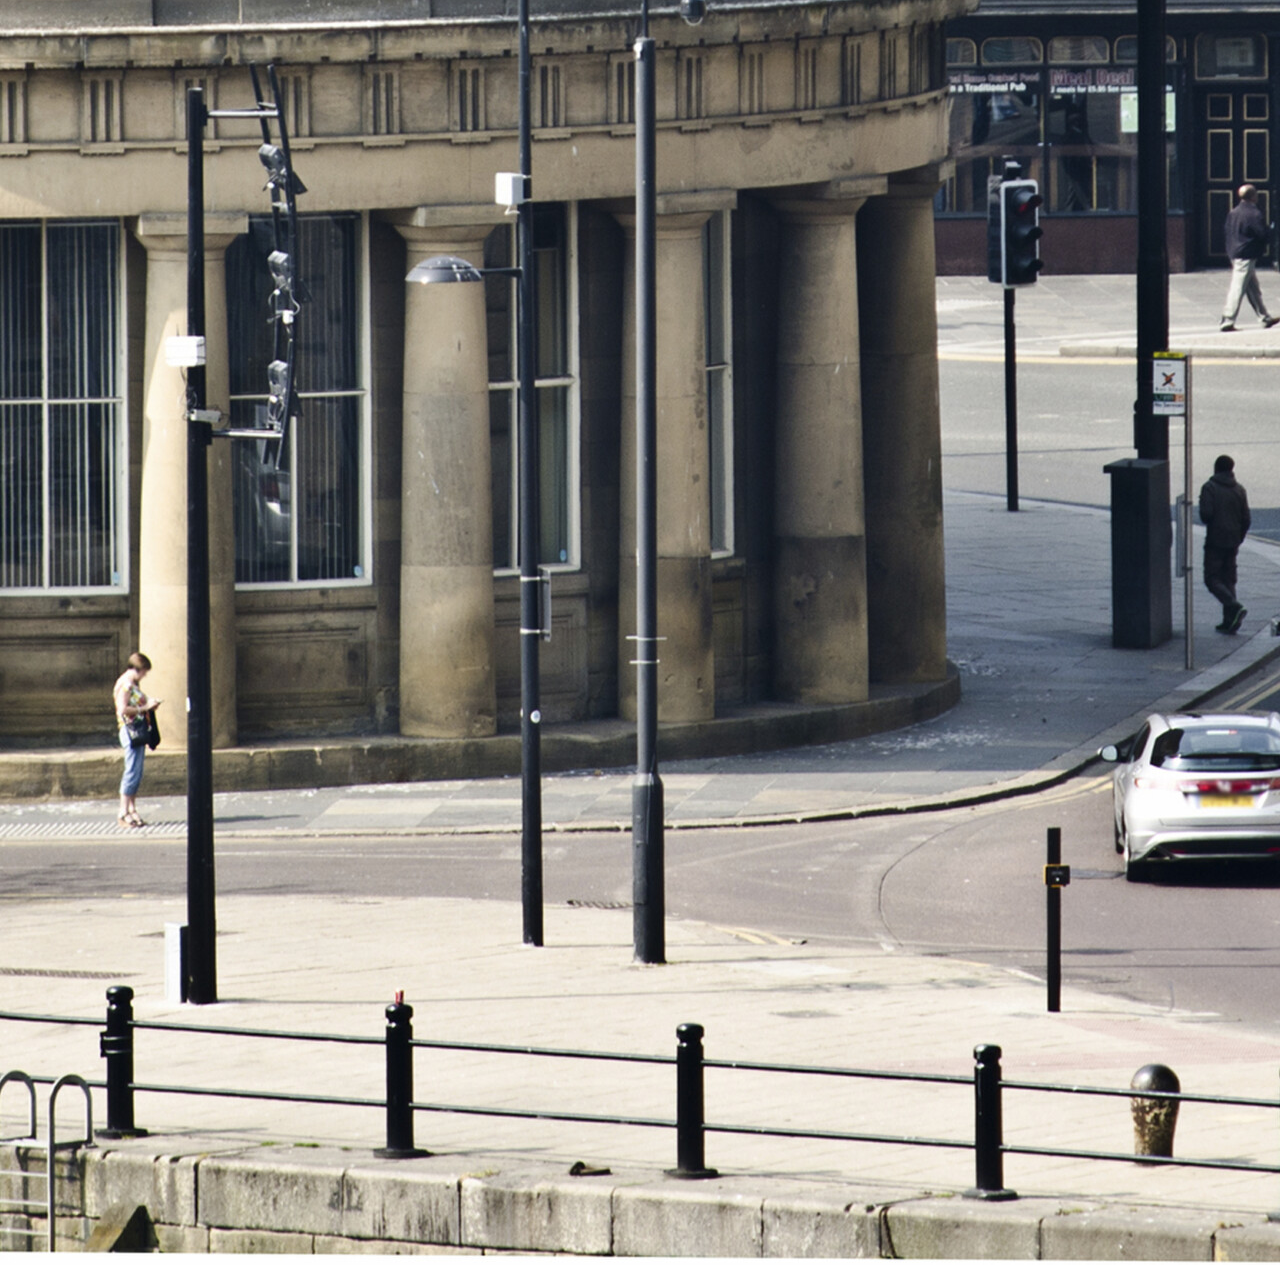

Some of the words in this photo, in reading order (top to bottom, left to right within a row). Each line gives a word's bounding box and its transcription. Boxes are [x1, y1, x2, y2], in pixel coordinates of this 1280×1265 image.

[1049, 68, 1092, 85] Meal
[1096, 68, 1135, 85] Deal
[965, 83, 1008, 92] Traditional
[1010, 82, 1026, 91] Pub
